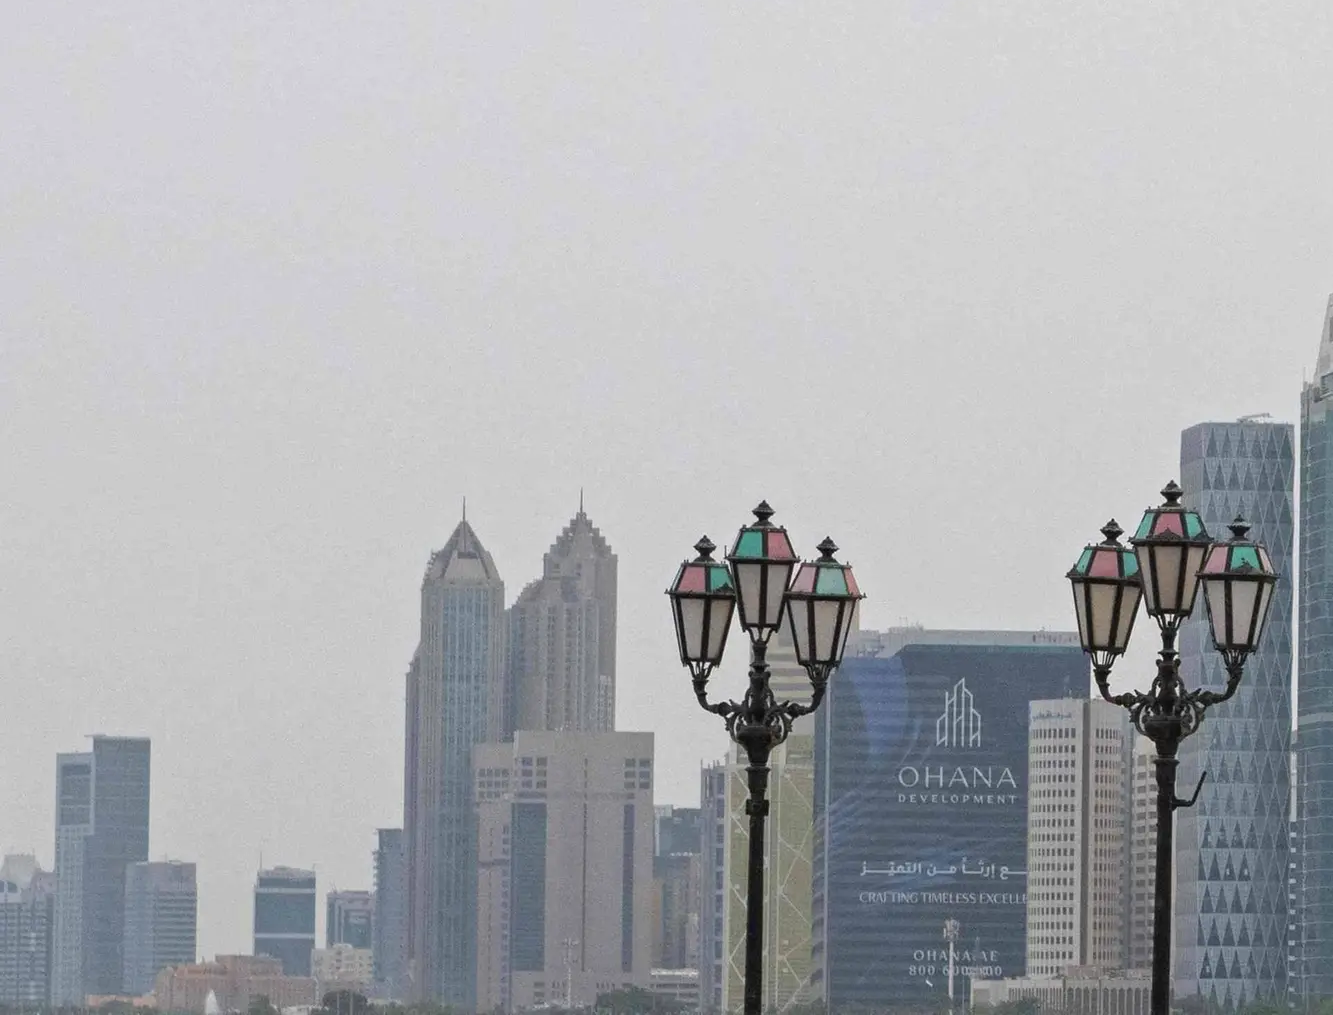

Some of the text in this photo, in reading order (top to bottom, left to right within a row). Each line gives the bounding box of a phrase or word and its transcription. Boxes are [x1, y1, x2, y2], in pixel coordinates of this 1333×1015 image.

[898, 766, 1017, 788] OHANA
[898, 794, 1017, 804] DEVELOPMENT
[926, 863, 957, 877] من
[859, 891, 919, 904] CRAFTING
[920, 891, 976, 904] TIMELESS
[908, 964, 936, 976] 800
